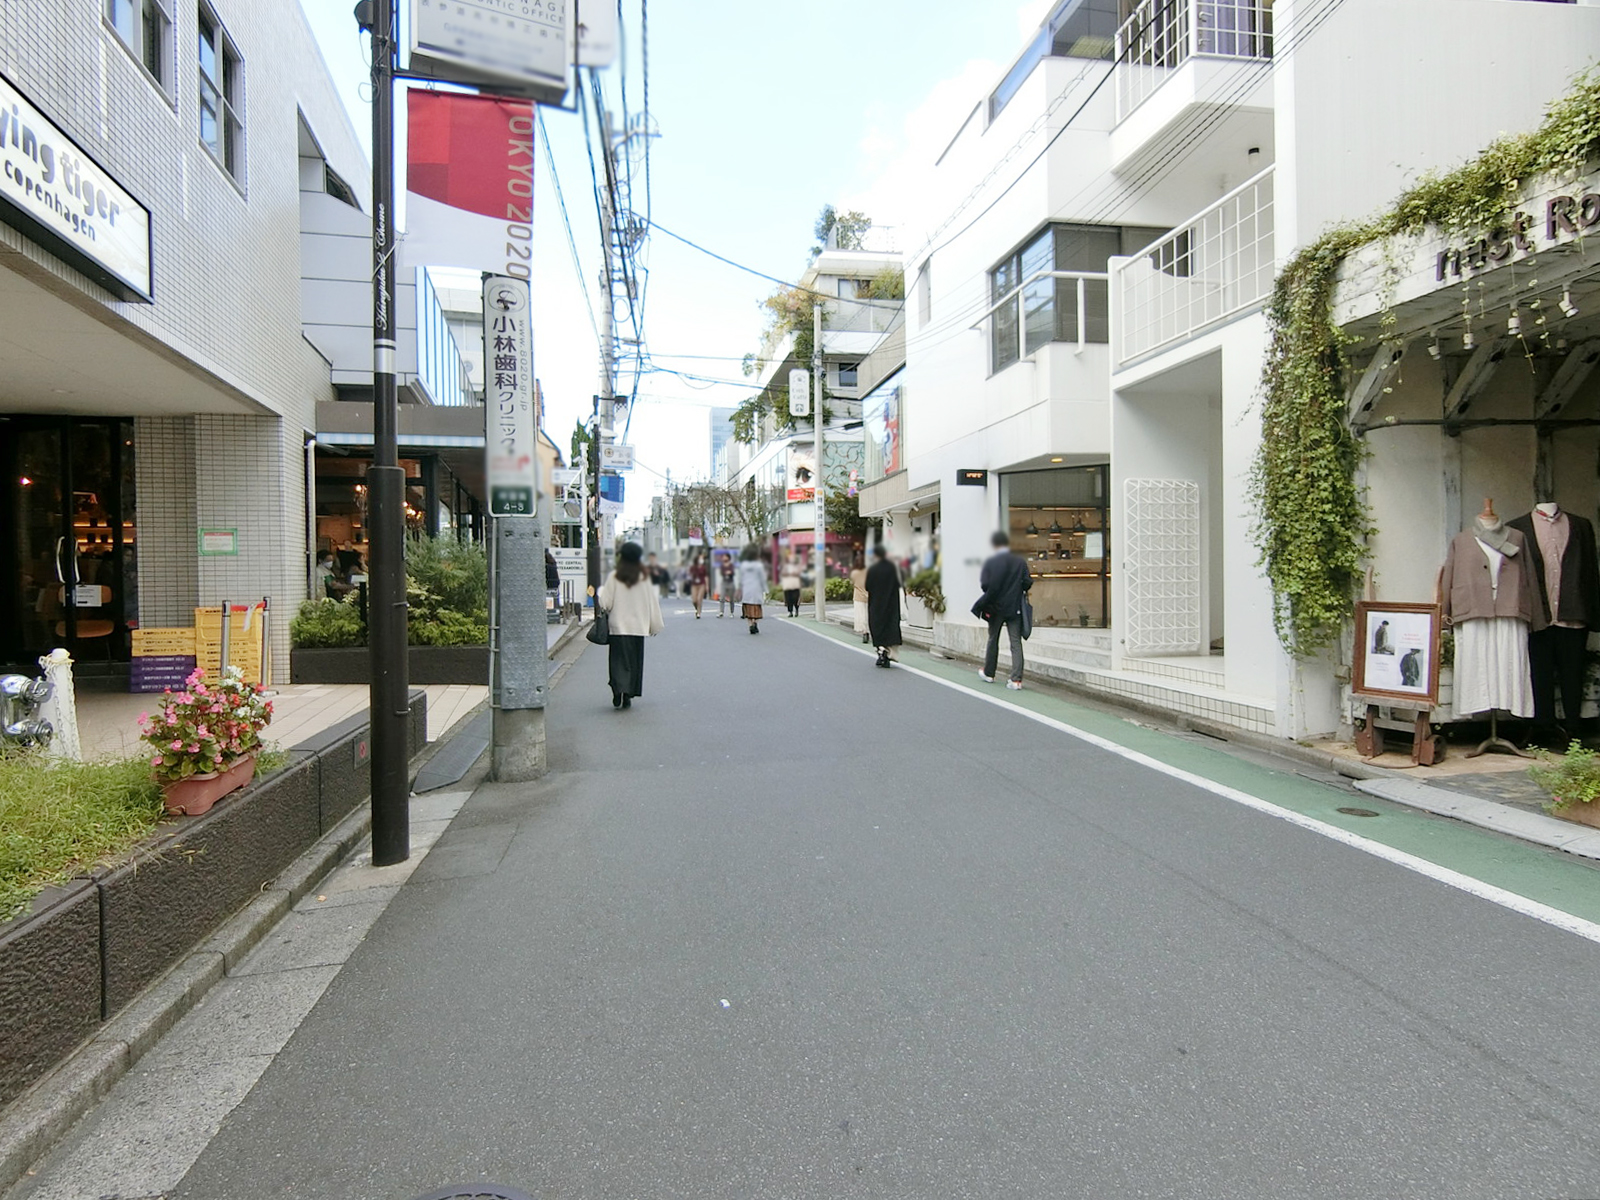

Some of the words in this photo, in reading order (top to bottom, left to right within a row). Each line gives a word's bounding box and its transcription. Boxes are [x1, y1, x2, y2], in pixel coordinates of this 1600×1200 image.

[522, 6, 564, 24] OFFICE
[4, 159, 96, 241] copenhagen
[60, 151, 120, 227] tiger
[375, 203, 386, 249] Chome
[506, 204, 533, 280] 2020
[375, 267, 391, 331] Harajuku
[492, 315, 518, 447] 小林歯科クリニック
